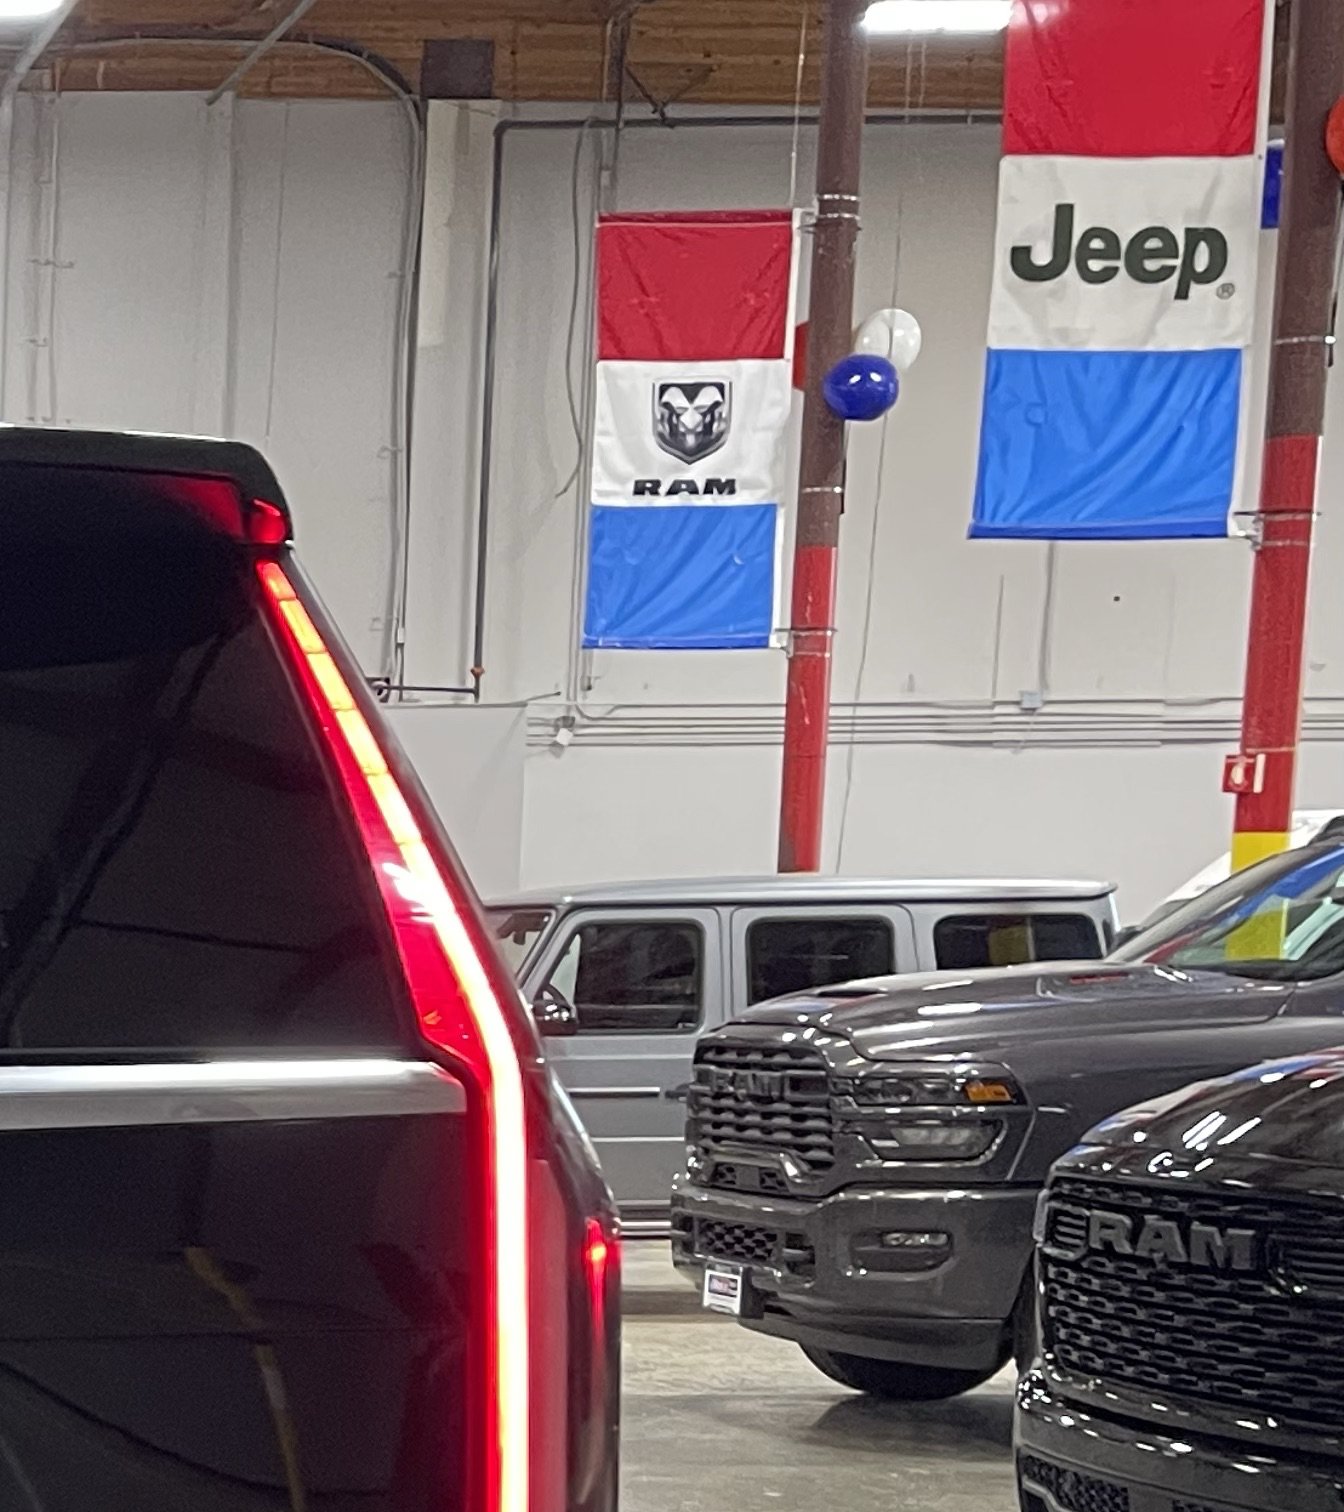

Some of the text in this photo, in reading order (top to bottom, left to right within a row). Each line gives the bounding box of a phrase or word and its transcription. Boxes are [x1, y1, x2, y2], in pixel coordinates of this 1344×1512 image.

[1010, 203, 1228, 300] Jeep
[633, 478, 736, 496] RAM
[1089, 1209, 1256, 1270] RAM
